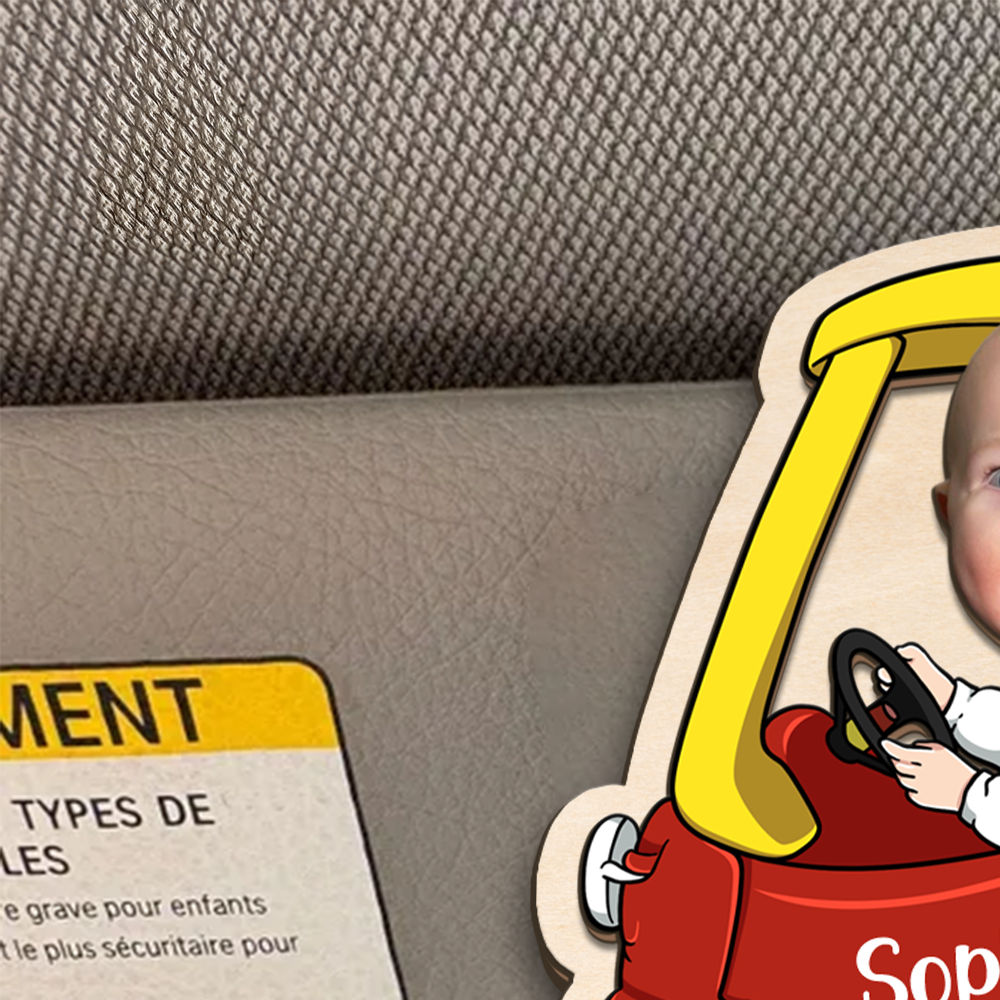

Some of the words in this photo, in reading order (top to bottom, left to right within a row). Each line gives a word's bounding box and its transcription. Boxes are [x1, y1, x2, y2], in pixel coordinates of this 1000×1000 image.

[0, 678, 203, 750] MENT
[11, 796, 143, 830] TYPES
[157, 794, 216, 827] DE
[0, 845, 71, 877] LES
[0, 902, 20, 921] e
[26, 901, 98, 926] grave
[105, 898, 163, 922] pour
[171, 893, 268, 917] enfants
[12, 939, 38, 961] le
[44, 937, 97, 965] plus
[102, 934, 235, 960] sécuritaire
[242, 933, 300, 959] pour
